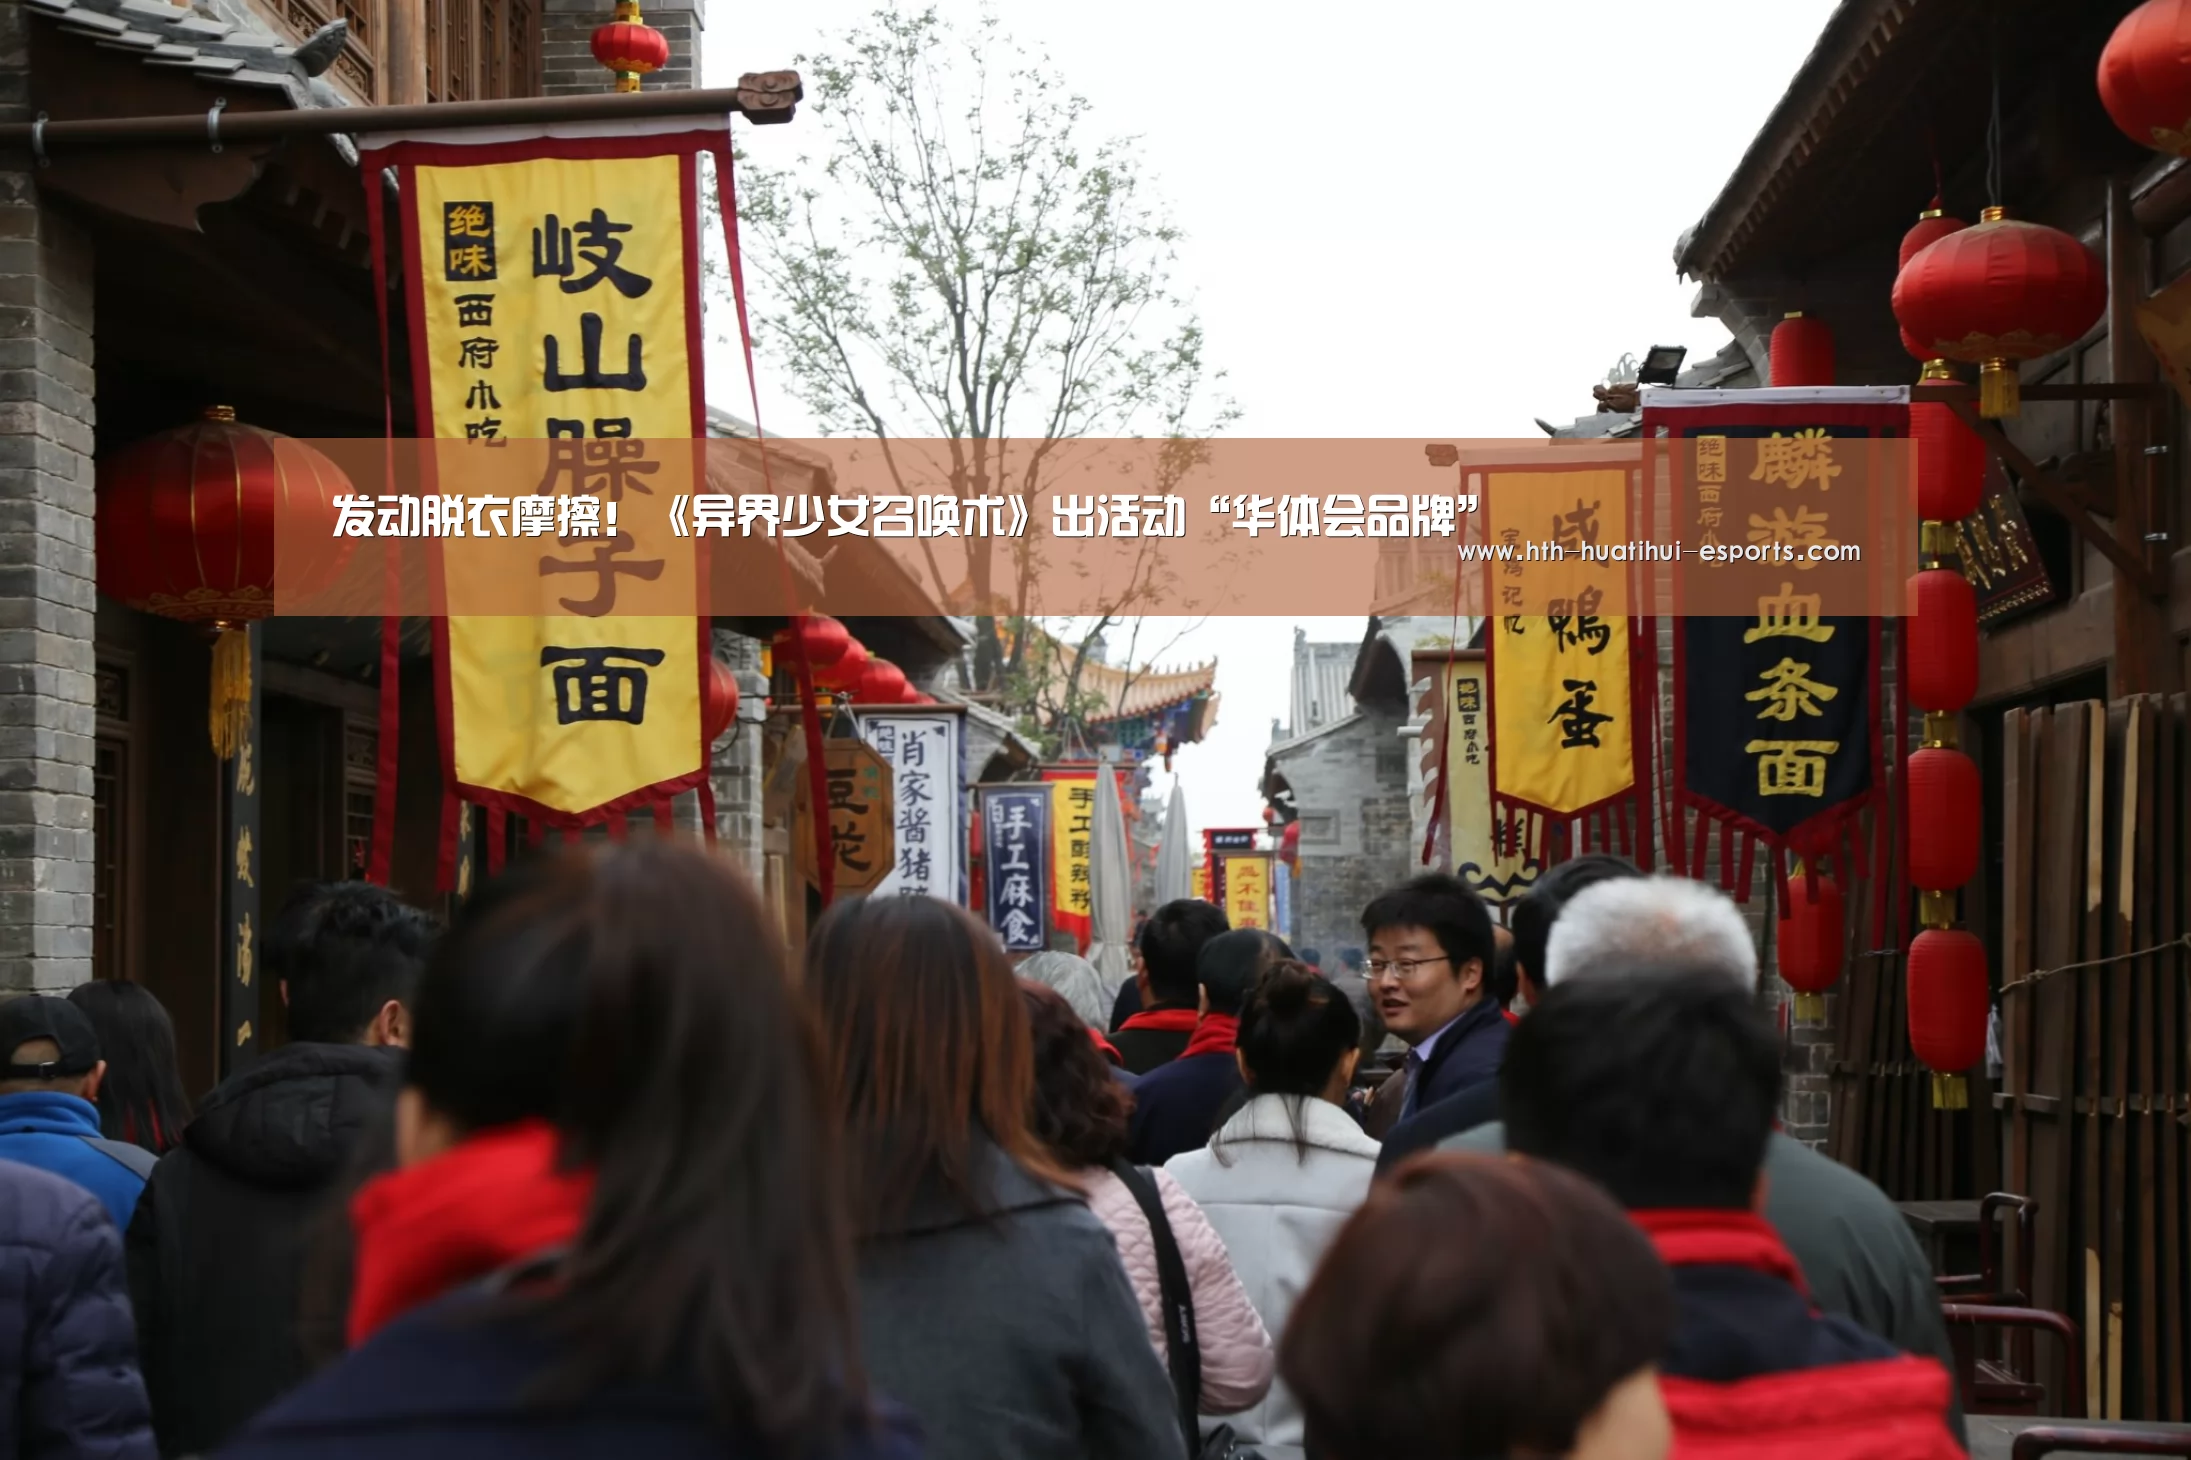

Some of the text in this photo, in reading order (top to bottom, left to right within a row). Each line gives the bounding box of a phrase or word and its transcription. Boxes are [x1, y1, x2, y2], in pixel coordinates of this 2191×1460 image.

[448, 204, 492, 277] 绝味
[454, 293, 507, 449] 西府小吃
[532, 207, 665, 725] 岐山臊子面
[1743, 427, 1842, 798] 麟游血条面
[1000, 805, 1035, 944] 手工麻食
